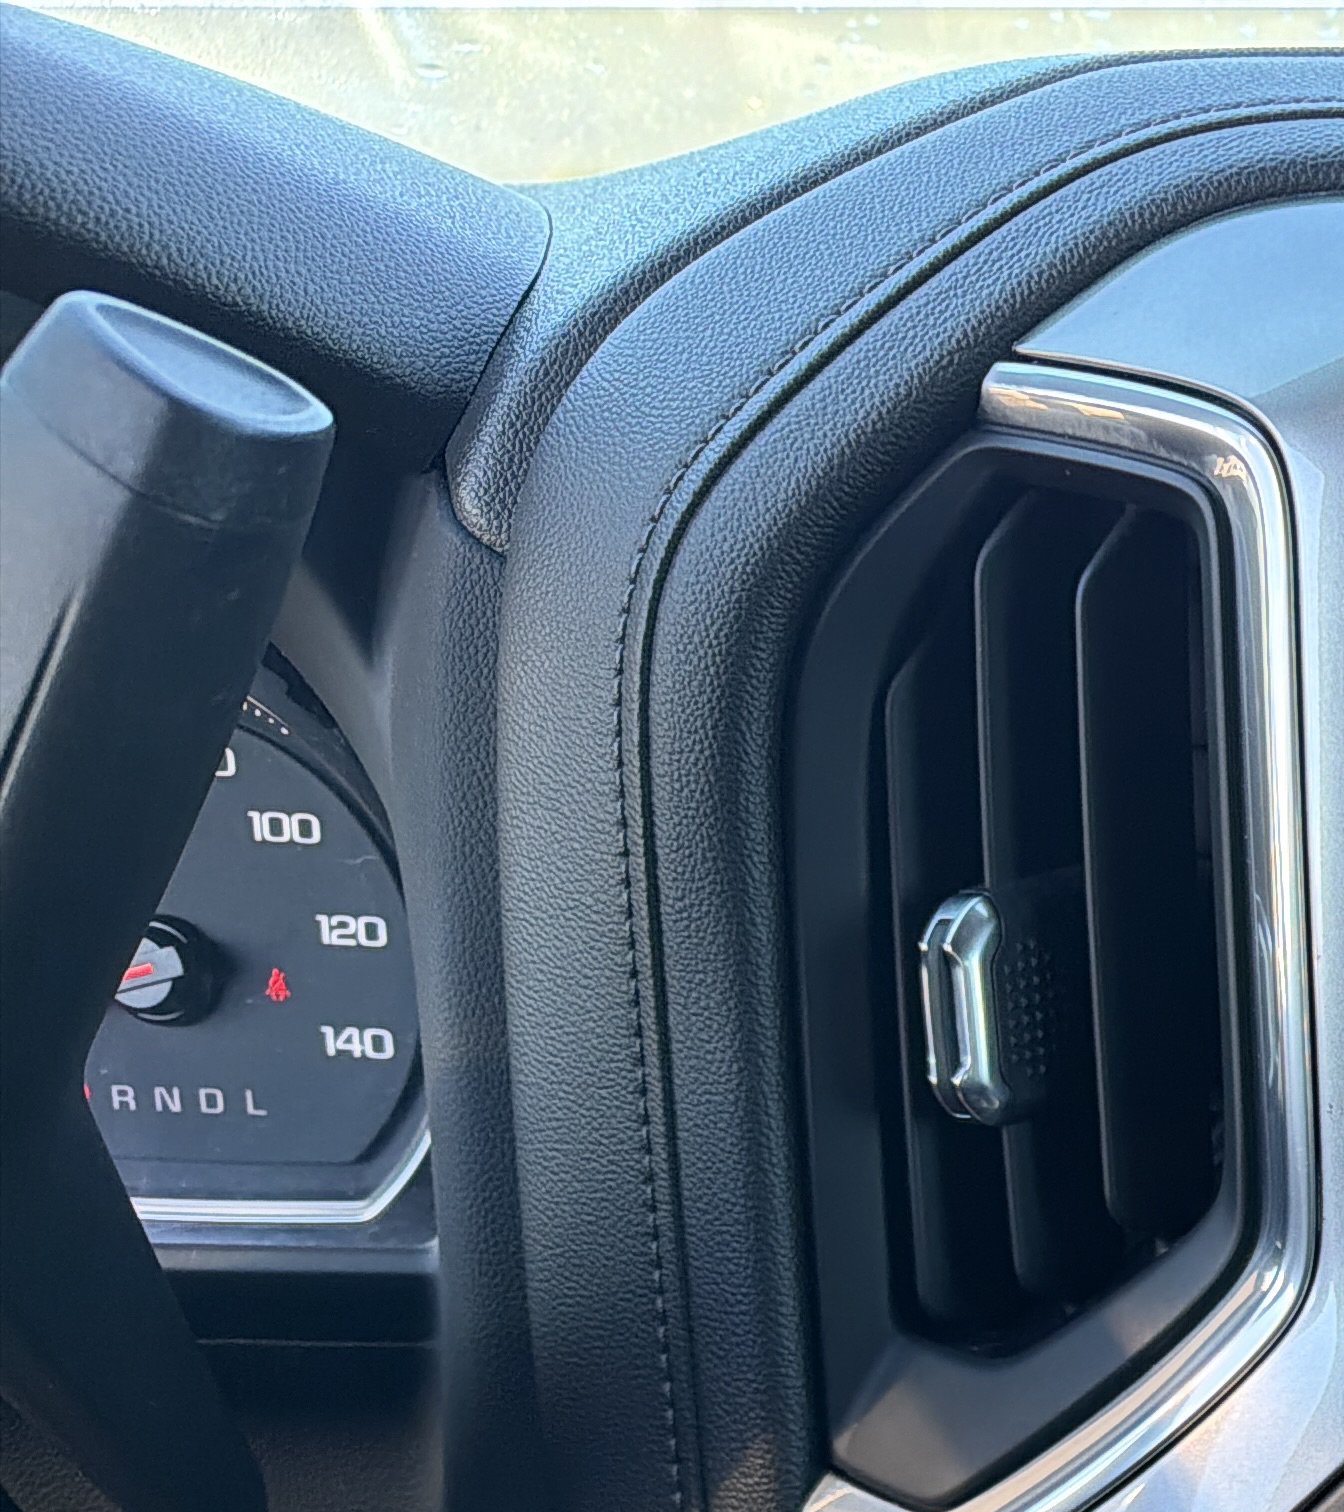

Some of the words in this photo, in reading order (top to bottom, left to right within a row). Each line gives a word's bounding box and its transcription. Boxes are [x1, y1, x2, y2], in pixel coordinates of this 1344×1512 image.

[247, 810, 322, 845] 100
[315, 914, 388, 948] 120
[320, 1025, 395, 1060] 140
[110, 1084, 137, 1111] R
[153, 1086, 182, 1113] N
[198, 1087, 225, 1114] D
[244, 1089, 268, 1116] L
